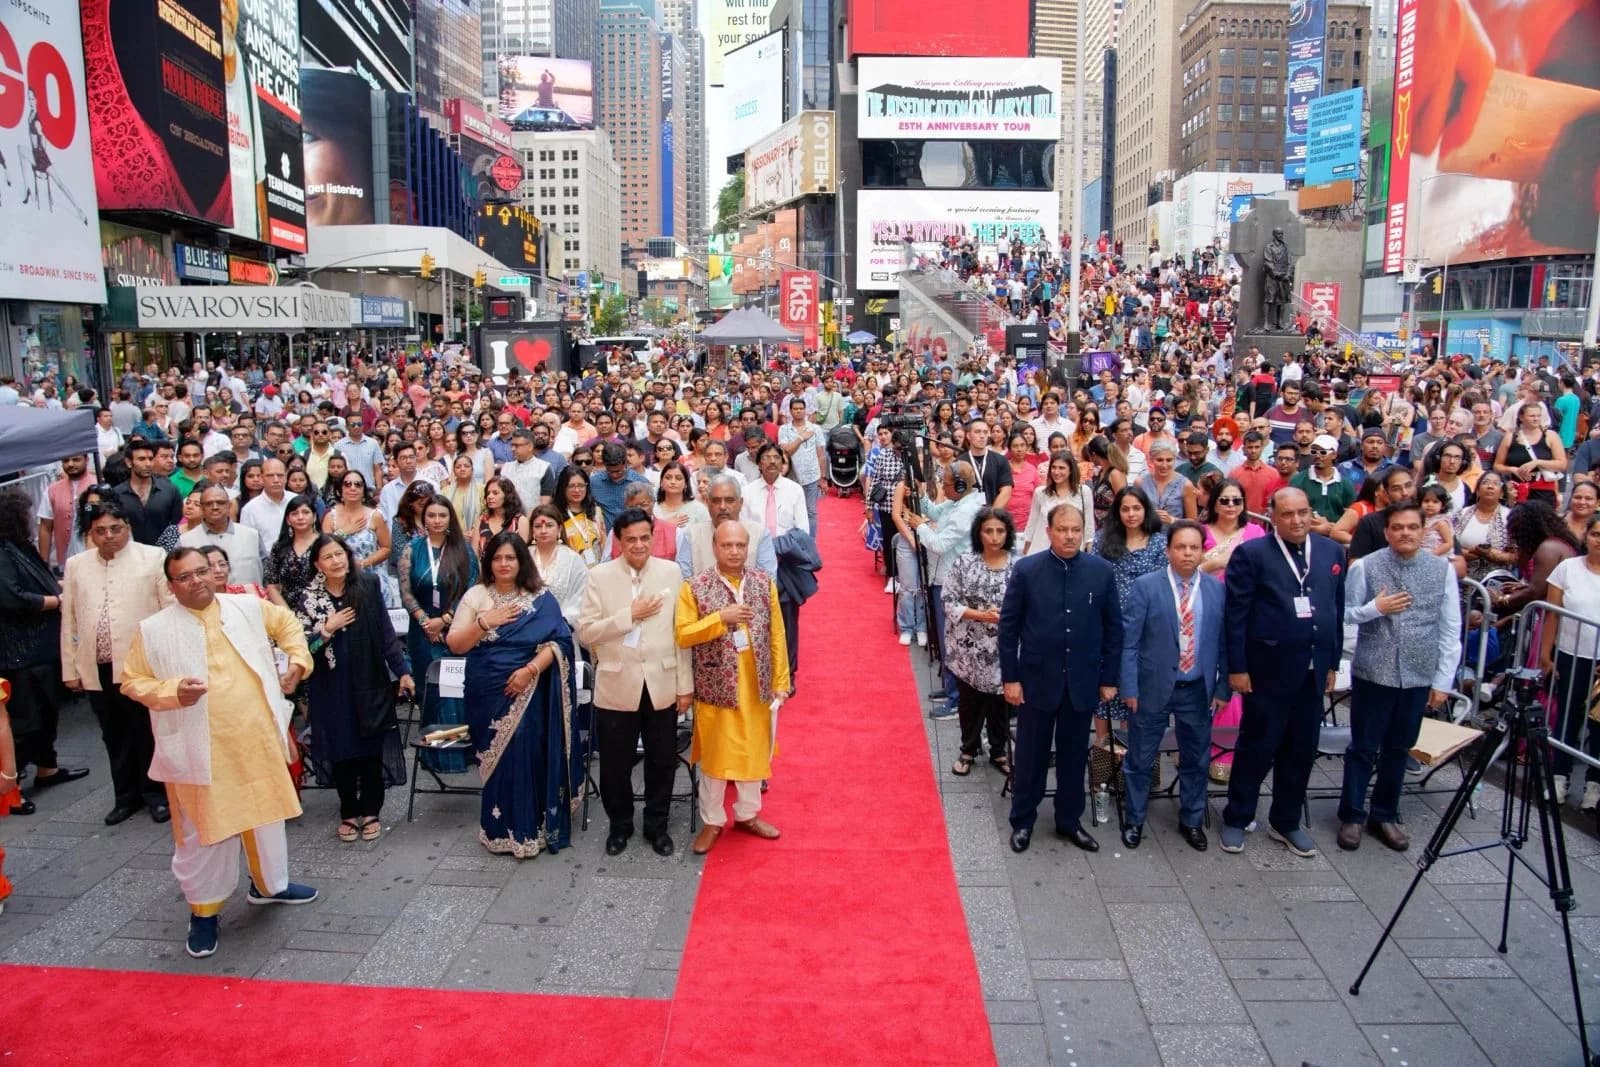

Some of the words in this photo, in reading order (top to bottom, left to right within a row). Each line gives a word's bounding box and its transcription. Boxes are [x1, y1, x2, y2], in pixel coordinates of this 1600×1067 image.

[271, 9, 298, 54] WHO
[727, 14, 748, 25] rest
[752, 12, 767, 25] for
[245, 19, 299, 85] ANSWERS
[718, 33, 742, 47] your
[1398, 8, 1417, 90] INSIDE!
[249, 53, 274, 94] THE
[274, 74, 301, 114] CALL
[898, 121, 922, 130] 25TH
[926, 121, 999, 131] ANNIVERSARY
[1003, 122, 1031, 131] TOUR
[307, 184, 325, 196] get
[326, 183, 364, 198] listening
[185, 246, 210, 267] BLUE
[213, 251, 228, 271] FIN
[63, 270, 81, 281] SINCE
[140, 296, 298, 318] SWAROVSKI
[303, 292, 351, 322] SWAROVSKI
[789, 274, 812, 321] tkts
[489, 340, 510, 375] I
